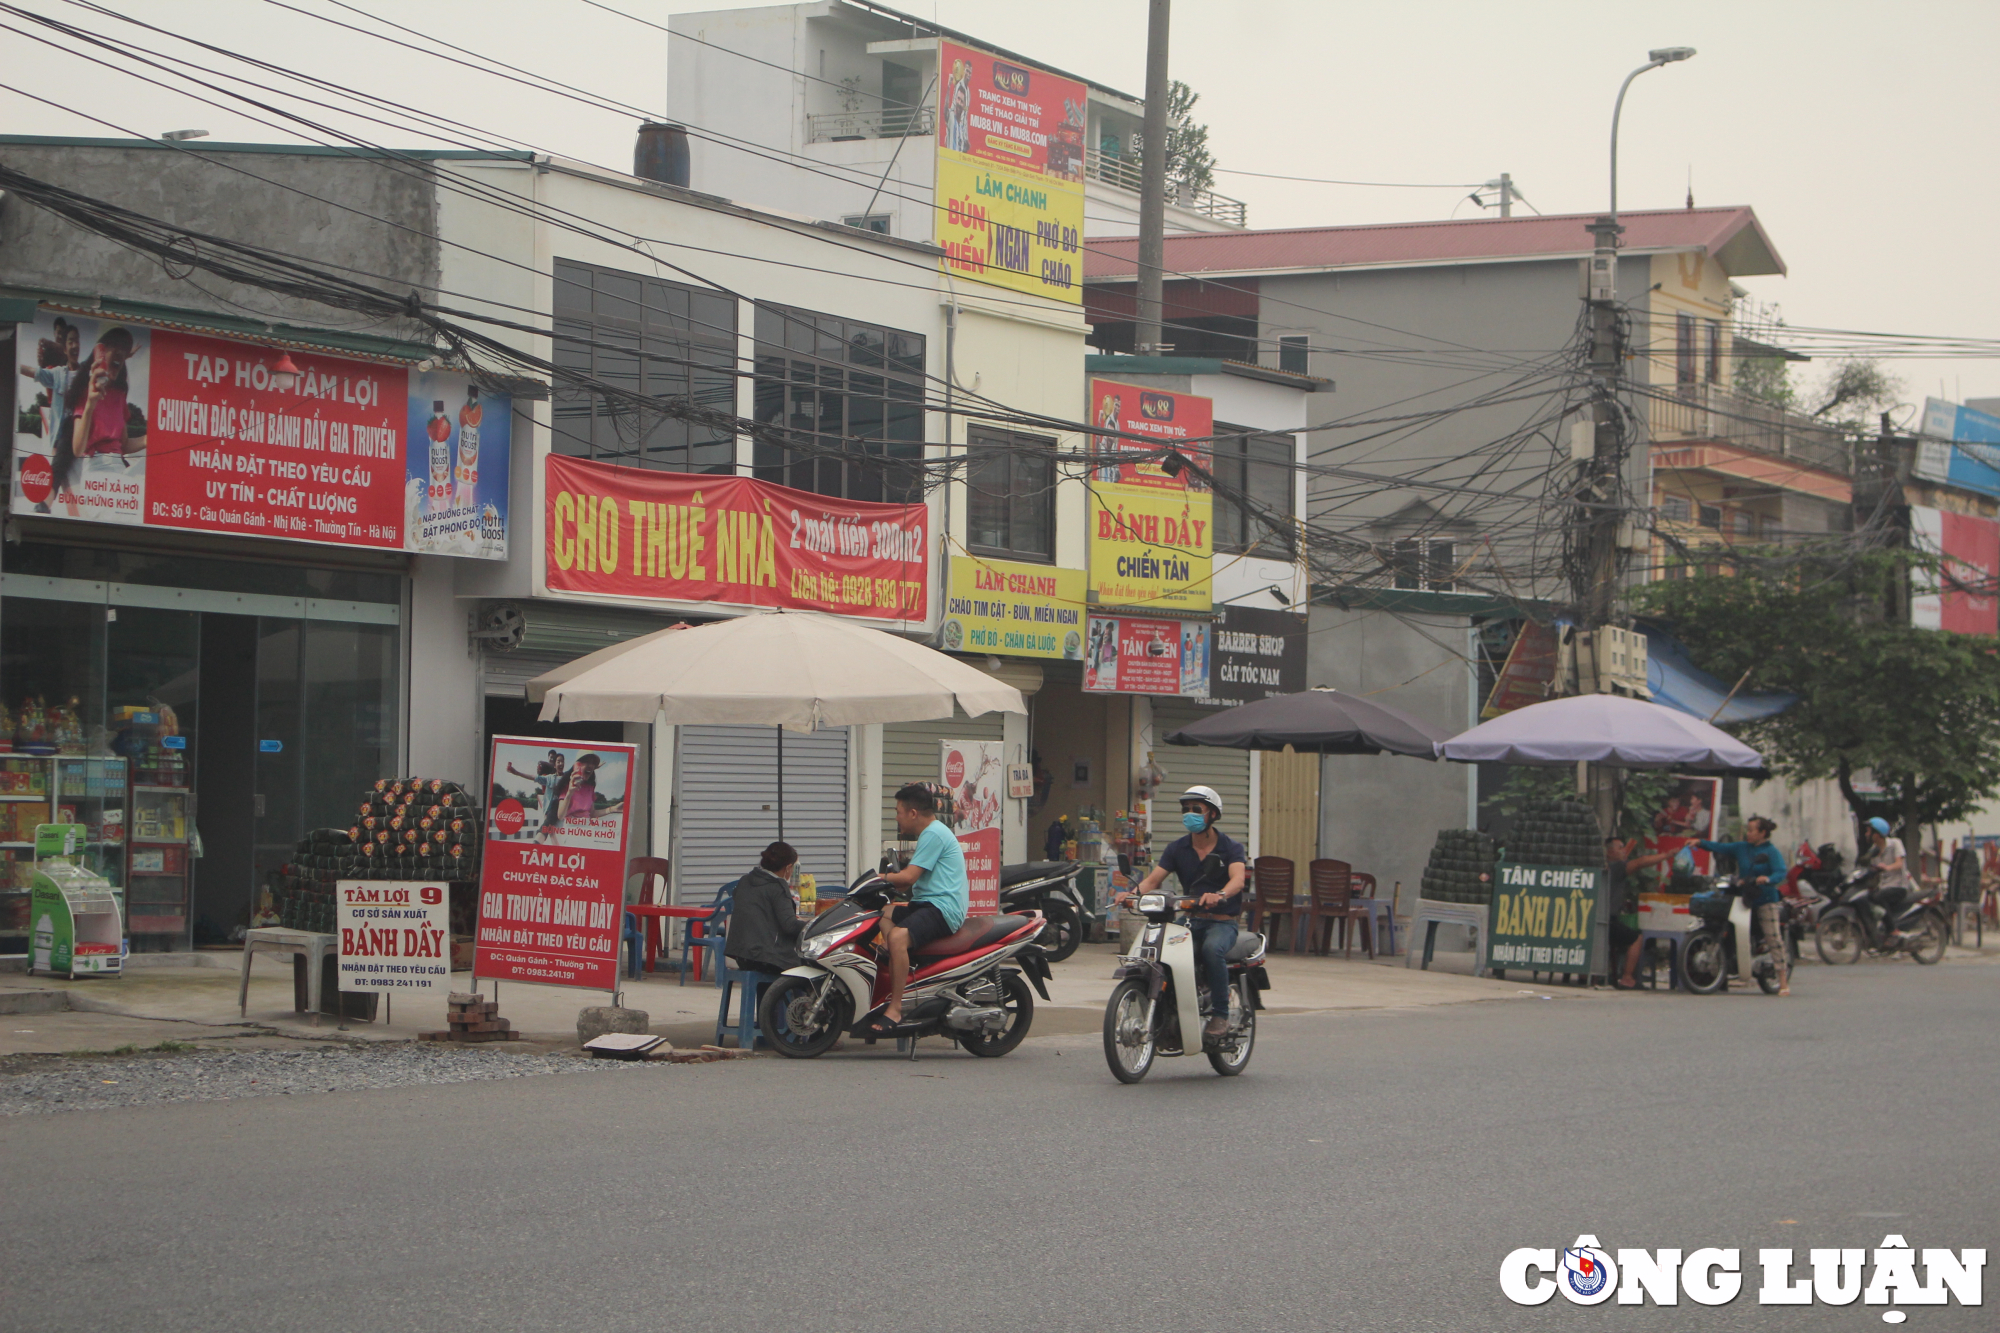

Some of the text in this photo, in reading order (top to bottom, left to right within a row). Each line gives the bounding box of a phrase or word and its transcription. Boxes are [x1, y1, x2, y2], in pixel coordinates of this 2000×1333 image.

[978, 89, 1001, 103] TRANG
[1002, 96, 1016, 108] XEM
[1017, 100, 1028, 111] TIN
[995, 107, 1013, 121] THAO
[1014, 113, 1028, 125] GIẢI
[1028, 117, 1039, 128] TRÍ
[1003, 126, 1009, 136] &
[975, 172, 1047, 211] LÂM CHANH
[948, 194, 985, 232] BÚN
[995, 223, 1030, 273] NGAN
[1036, 217, 1078, 254] PHỞ BÒ
[940, 234, 984, 275] MIẾN
[1041, 258, 1072, 289] CHÁO
[184, 352, 229, 388] TẠP
[294, 366, 337, 401] TÂM
[343, 375, 378, 411] LỢI
[157, 395, 396, 460] CHUYÊN ĐẶC SẢN BÁNH DẦY GIA TRUYỀN
[189, 449, 371, 487] NHẬN ĐẶT THEO YÊU CẦU
[84, 478, 108, 492] NGHỈ
[123, 483, 139, 495] HƠI
[206, 480, 357, 515] UY TÍN CHẤT LƯỢNG
[116, 496, 139, 510] KHỞI
[152, 501, 396, 542] ĐC: Số 9 Cầu Quán Gánh Nhị Khê Thường Tín Hà Nội
[481, 515, 505, 528] nutri
[481, 527, 505, 541] boost
[1097, 503, 1206, 548] BÁNH DẦY
[554, 490, 777, 588] CHO THUÊ NHÀ
[789, 509, 923, 563] 2 mặt tiền 300m2
[1116, 549, 1189, 581] CHIẾN TÂN
[790, 567, 922, 611] Liên hệ: 0928 589 777
[1008, 573, 1057, 597] CHANH
[949, 596, 1078, 625] CHÁO TIM CẬT BÚN, MIẾN NGAN
[970, 625, 986, 646] PHỞ
[987, 628, 998, 647] BÒ
[1004, 630, 1025, 649] CHÂN
[1026, 631, 1036, 650] GÀ
[1122, 636, 1143, 657] TÂN
[1218, 630, 1284, 657] BARBER SHOP
[1220, 655, 1280, 686] CẮT TÓC NAM
[567, 826, 592, 837] HỨNG
[519, 849, 586, 872] TÂM LỢI
[502, 871, 599, 889] CHUYÊN ĐẶC SẢN
[1501, 865, 1595, 889] TÂN CHIẾN
[344, 886, 443, 905] TÂM LỢI 9
[482, 888, 615, 930] GIA TRUYỀN BÁNH DẦY
[352, 907, 428, 919] CƠ SỞ SẢN XUẤT
[1495, 887, 1594, 940] BÁNH DẦY
[341, 920, 445, 958] BÁNH DẦY
[480, 926, 612, 953] NHẬN ĐẶT THEO YÊU CẦU
[490, 953, 599, 971] ĐC: Quán Gánh Thường Tín
[1492, 942, 1515, 965] NHẬN
[1515, 943, 1531, 966] ĐẶT
[1531, 946, 1552, 964] THEO
[1552, 945, 1568, 965] YÊU
[341, 962, 366, 973] NHẬN
[367, 963, 385, 974] ĐẶT
[386, 965, 408, 973] THEO
[409, 964, 426, 974] YÊU
[511, 966, 575, 979] ĐT: 0983.241.191
[354, 978, 368, 986] ĐT:
[415, 980, 432, 988] 191
